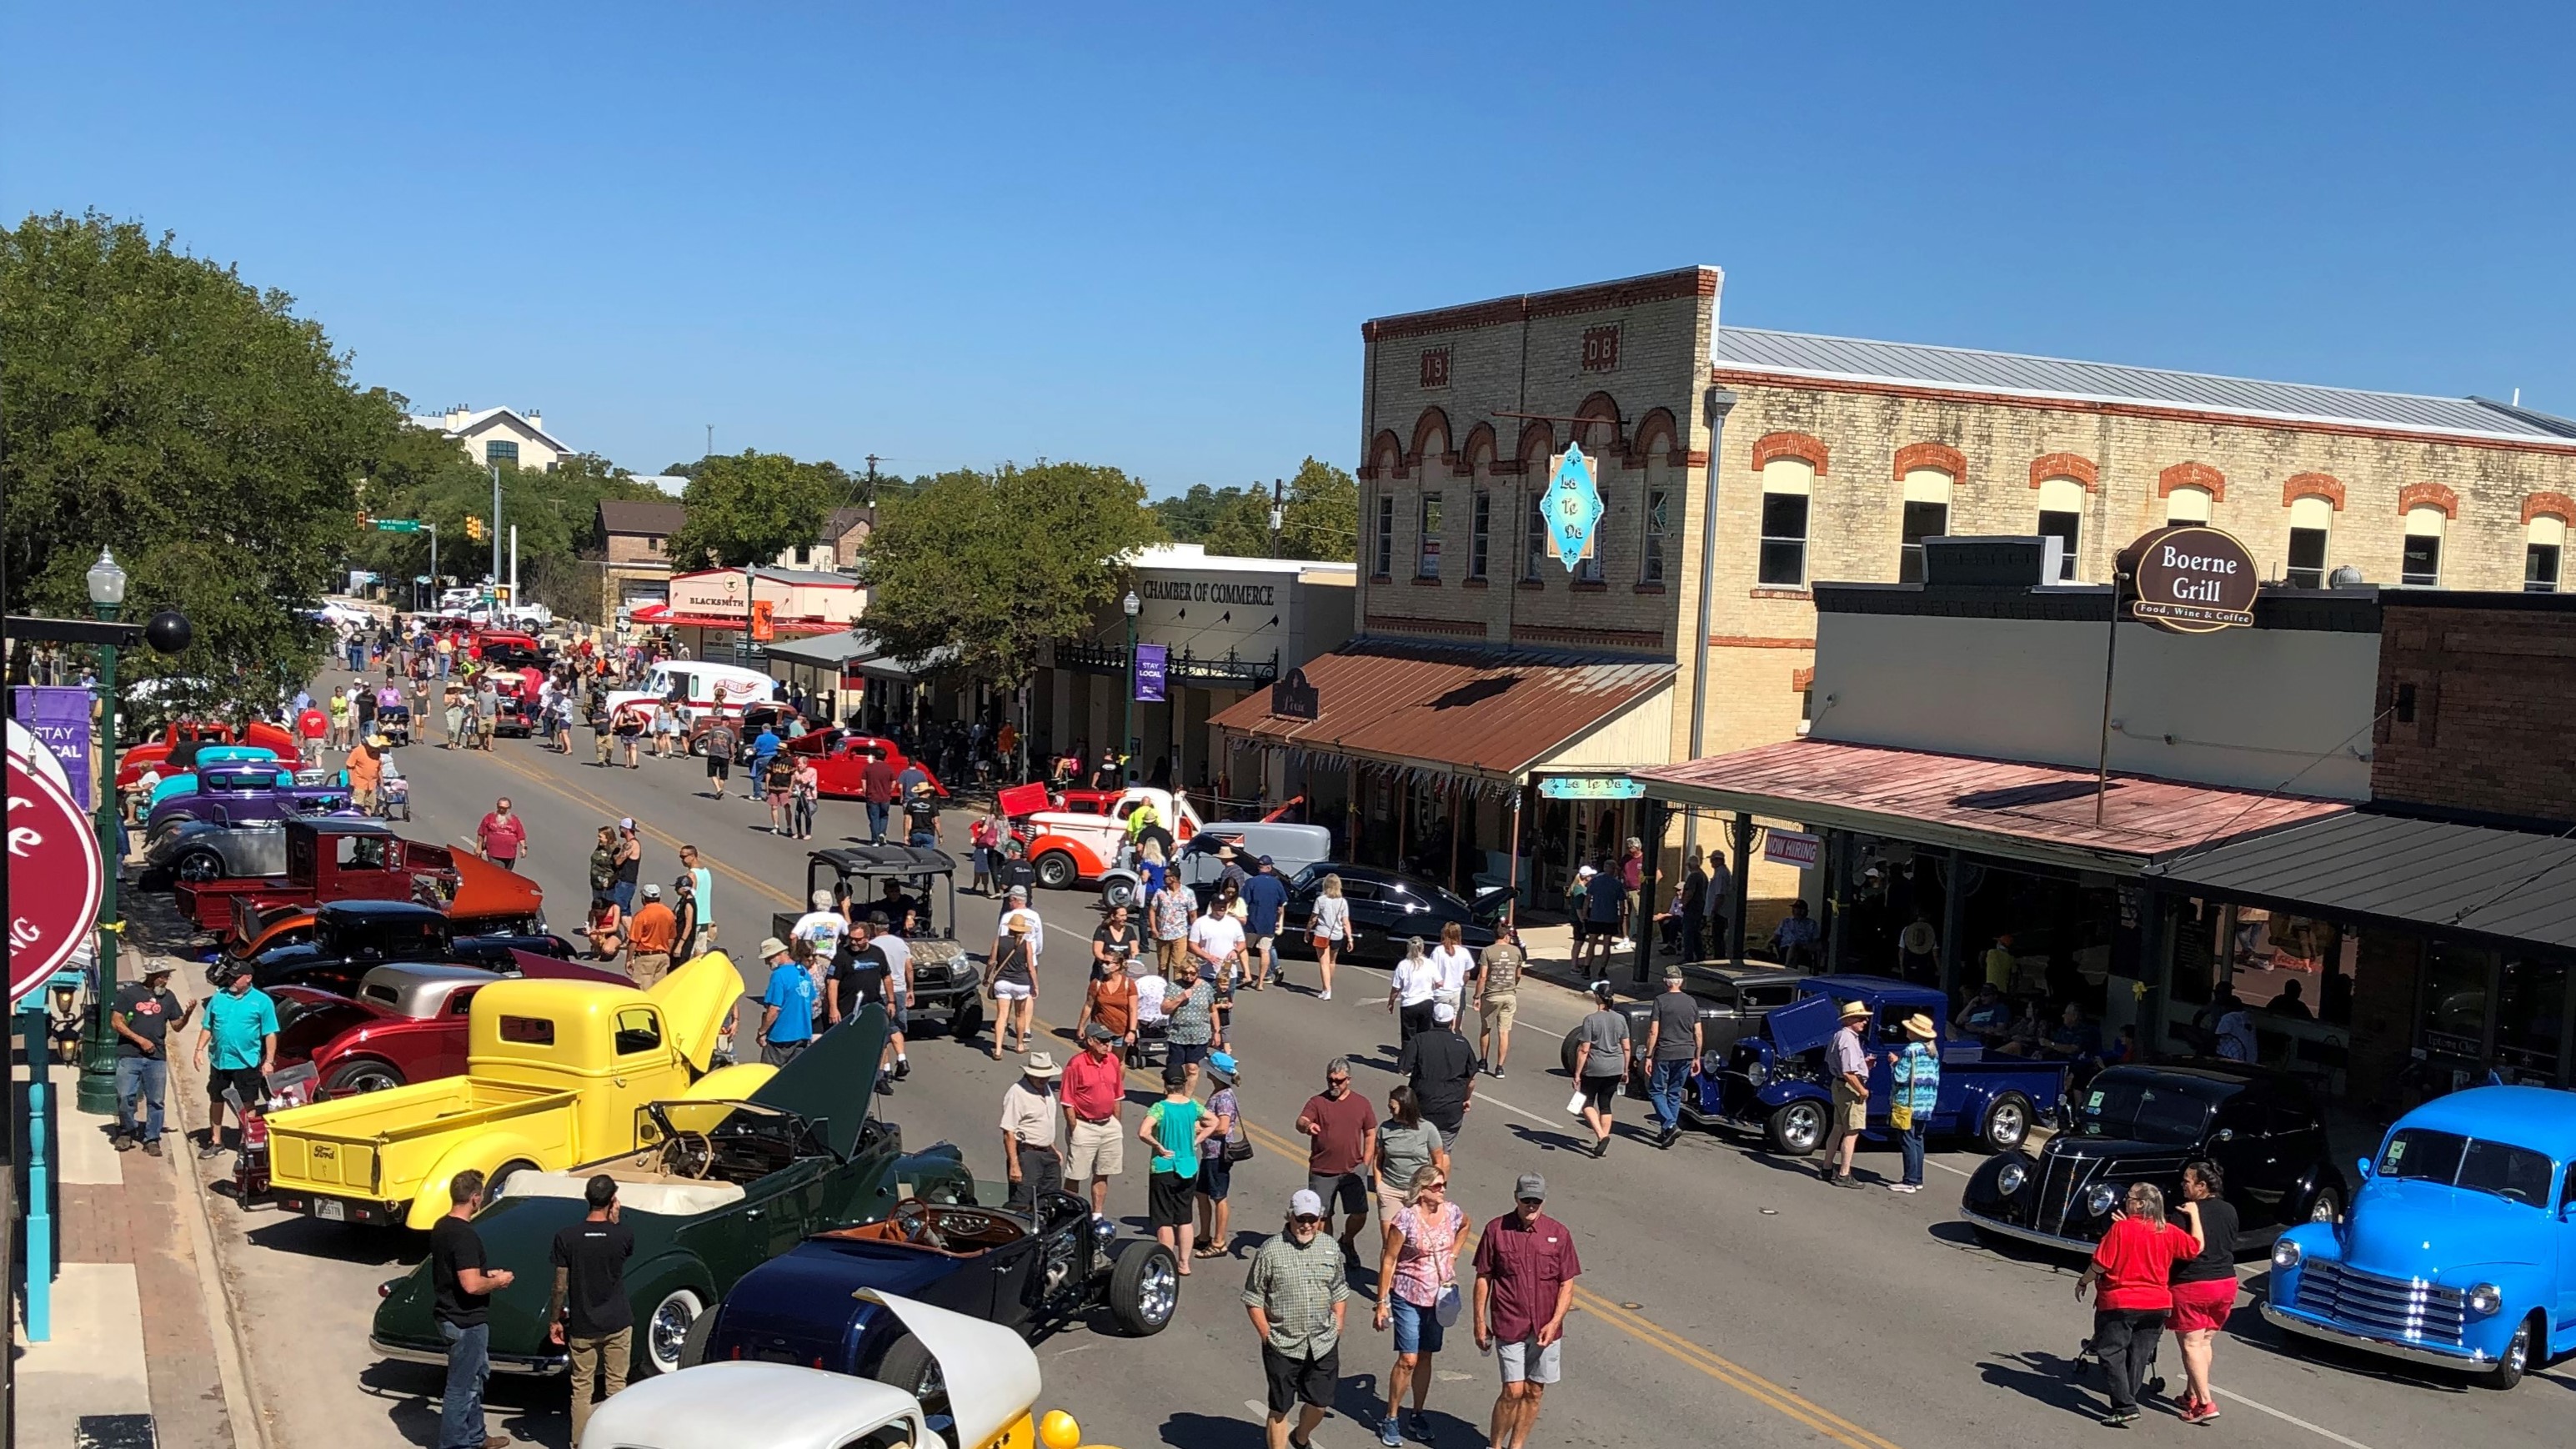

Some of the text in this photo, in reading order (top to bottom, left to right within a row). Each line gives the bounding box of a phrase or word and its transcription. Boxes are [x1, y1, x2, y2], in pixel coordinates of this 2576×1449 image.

[1426, 358, 1442, 379] 19
[2162, 545, 2238, 574] Boerne
[1144, 580, 1274, 606] CHAMBER OF COMMERCE
[2173, 577, 2221, 602] Grill
[689, 597, 744, 607] BLACKSMITH
[2140, 604, 2169, 615] Food,
[2174, 607, 2200, 618] Wine
[2216, 612, 2249, 623] Coffee
[34, 726, 74, 740] STAY
[1767, 836, 1817, 861] NOW HIRING
[313, 1145, 335, 1160] Ford
